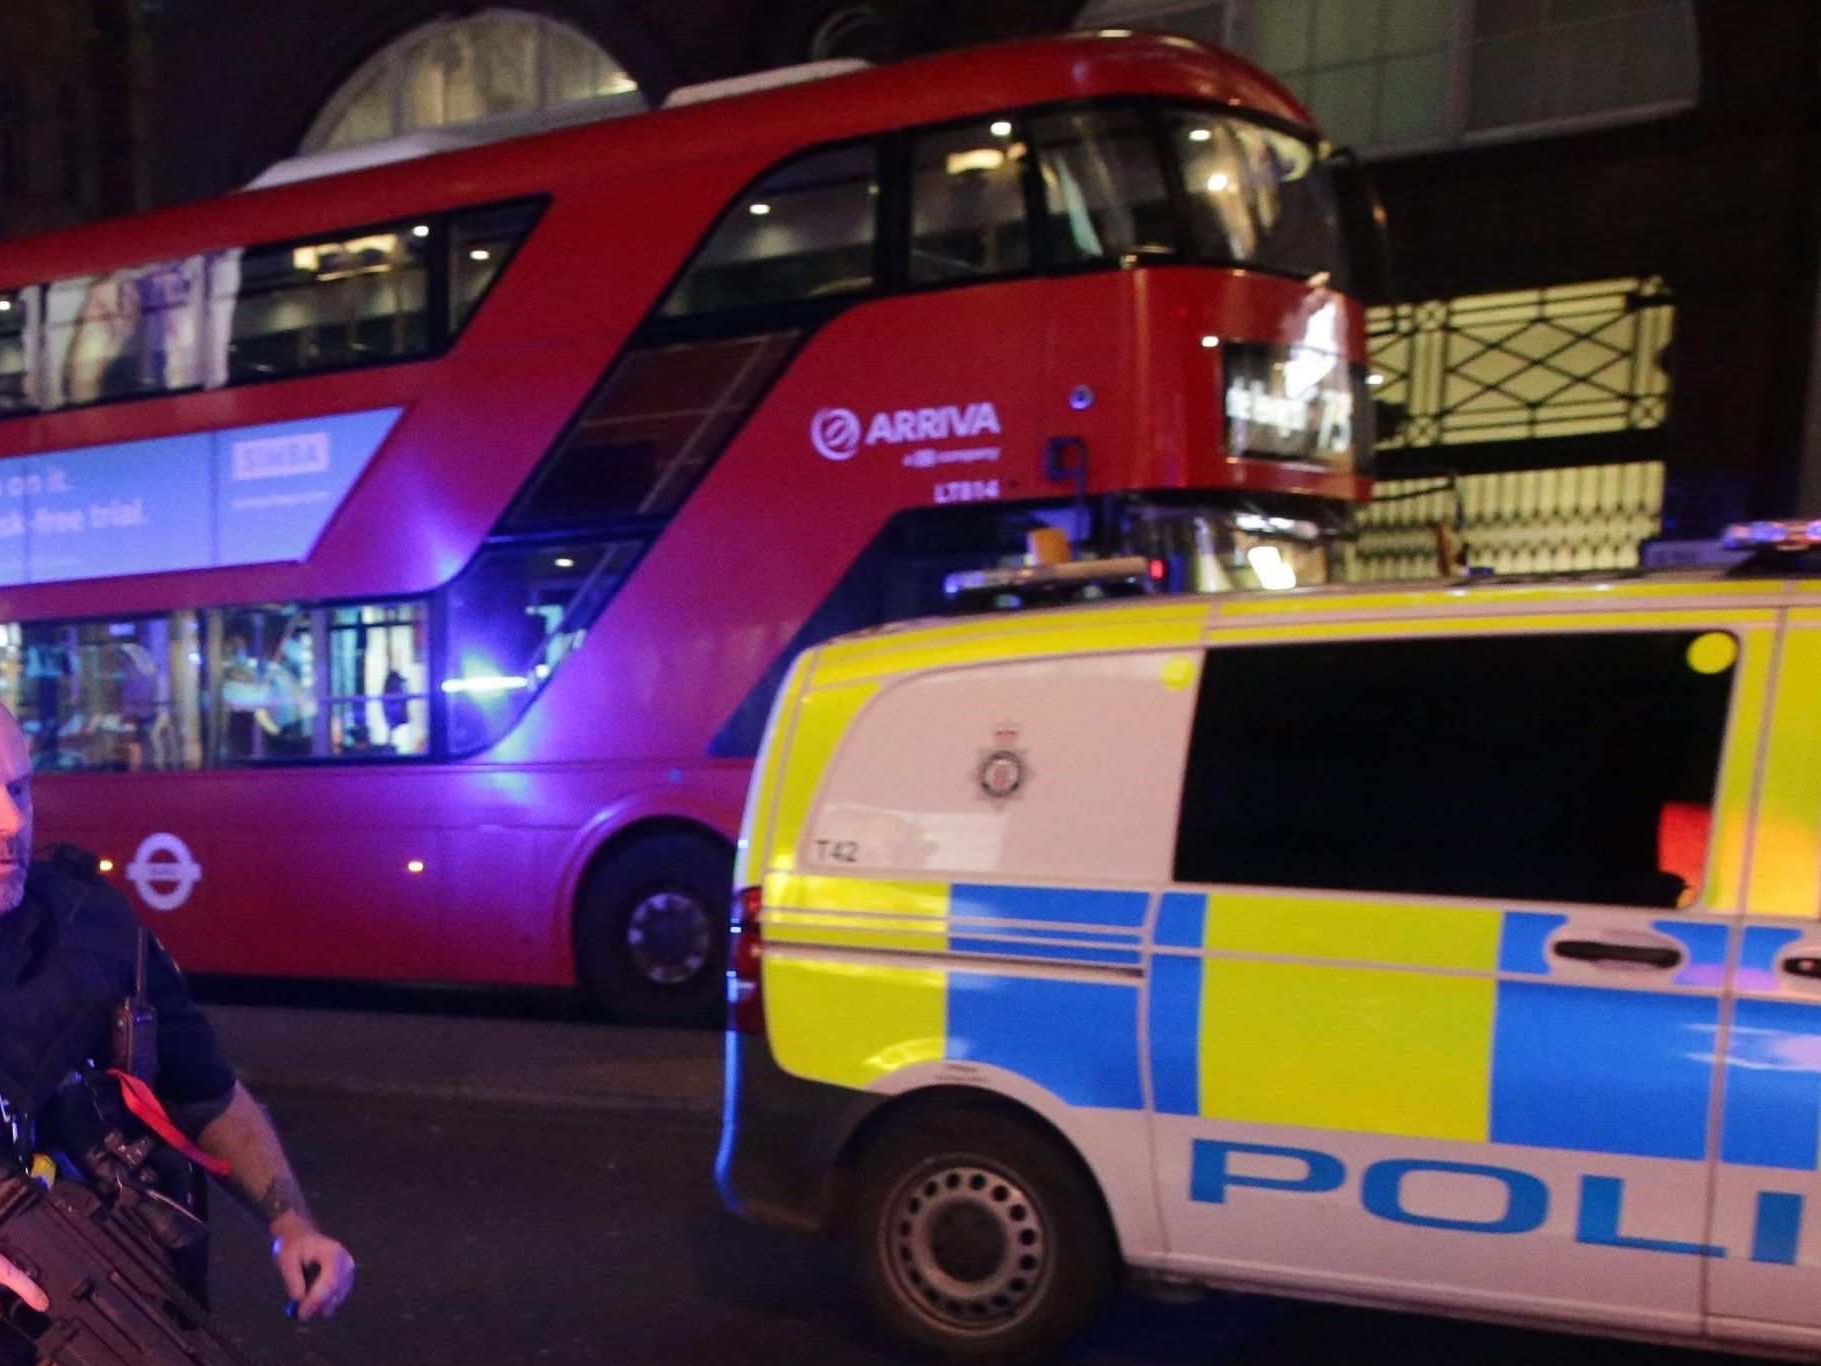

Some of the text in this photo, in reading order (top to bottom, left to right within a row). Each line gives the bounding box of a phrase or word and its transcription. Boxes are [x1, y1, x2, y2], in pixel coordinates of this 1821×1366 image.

[865, 400, 1002, 446] ARRIVA
[816, 839, 858, 863] T42
[1189, 1138, 1804, 1265] POLI
